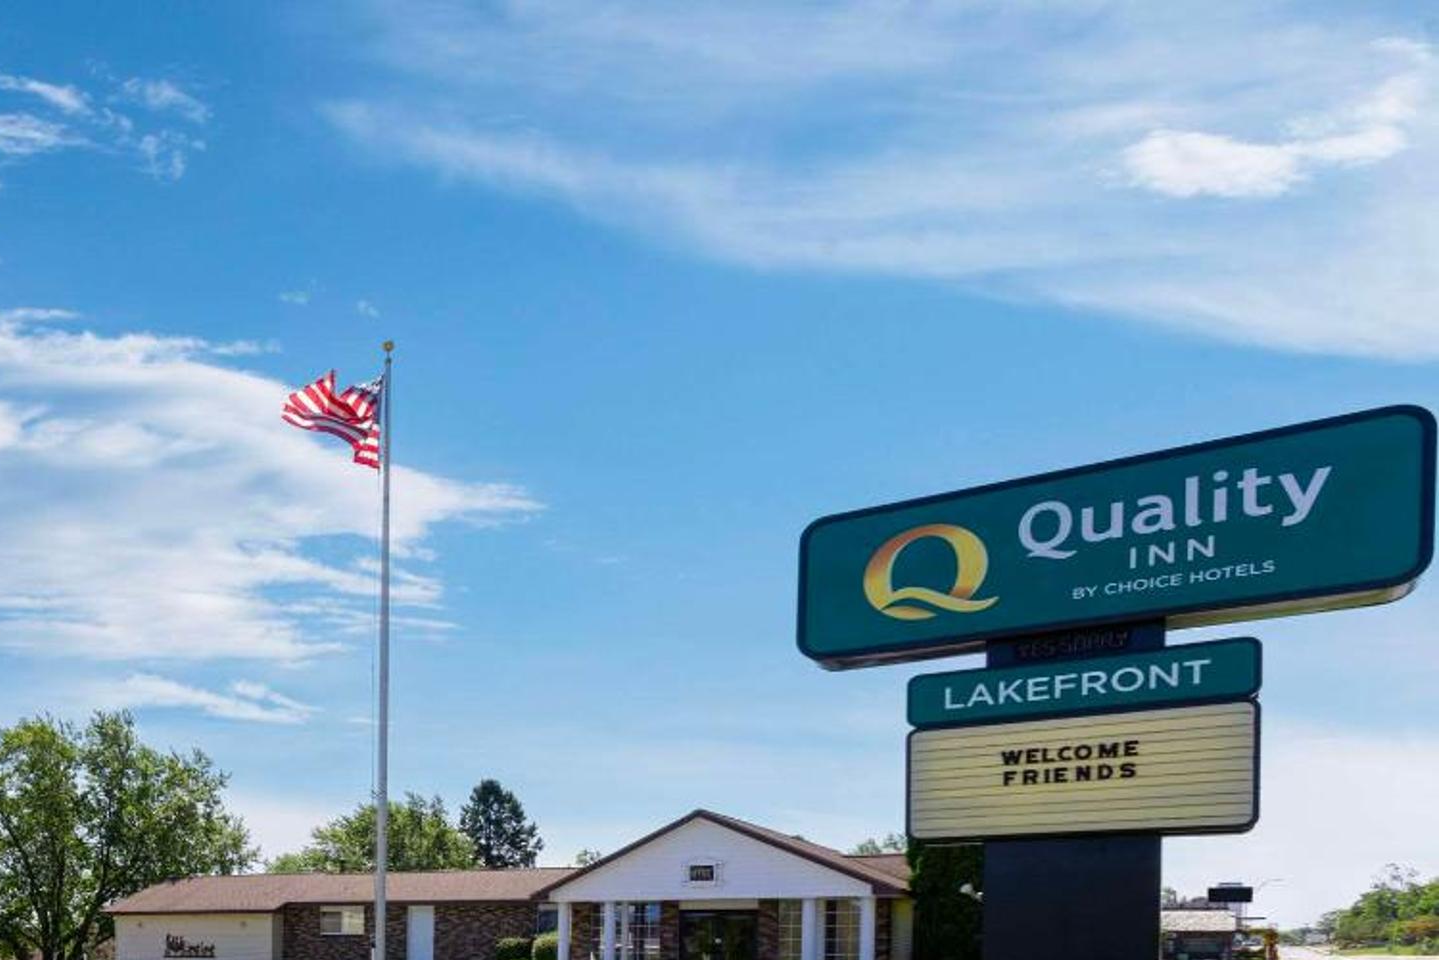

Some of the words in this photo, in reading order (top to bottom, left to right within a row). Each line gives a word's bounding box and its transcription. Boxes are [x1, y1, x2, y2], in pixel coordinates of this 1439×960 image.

[1018, 466, 1332, 559] Quality
[863, 523, 999, 620] Q
[1129, 535, 1215, 569] INN
[1072, 585, 1098, 600] BY
[1104, 572, 1183, 596] CHOICE
[1189, 560, 1275, 584] HOTELS
[944, 659, 1211, 710] LAKEFRONT
[1001, 740, 1139, 766] WELCOME
[1002, 762, 1137, 786] FRIENDS
